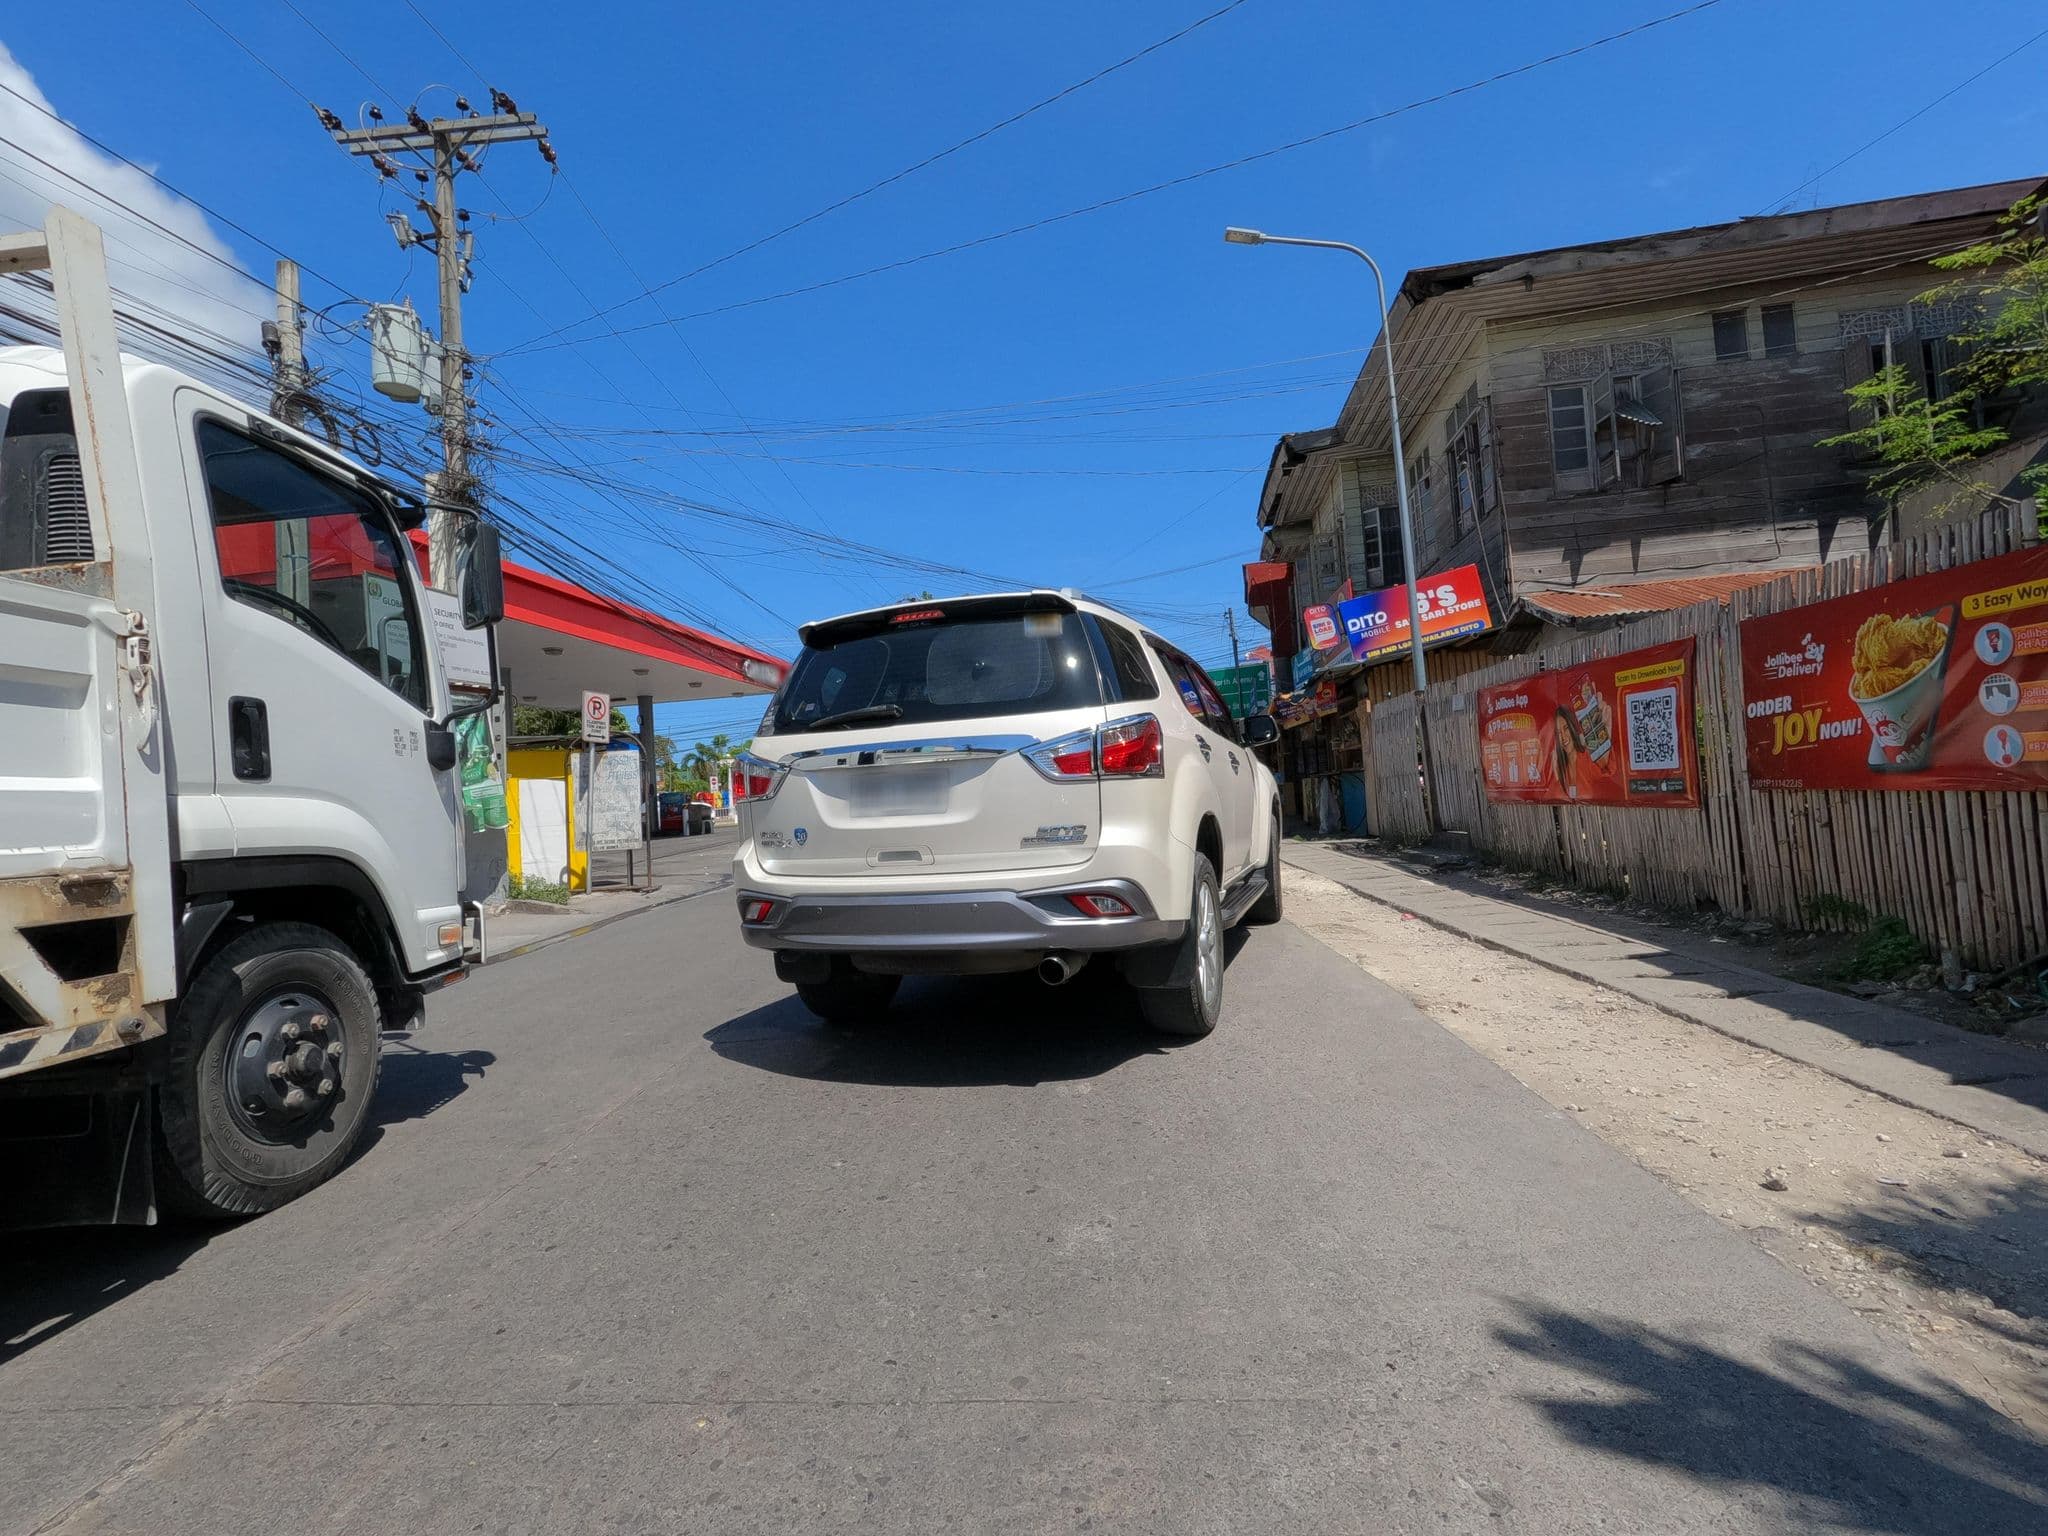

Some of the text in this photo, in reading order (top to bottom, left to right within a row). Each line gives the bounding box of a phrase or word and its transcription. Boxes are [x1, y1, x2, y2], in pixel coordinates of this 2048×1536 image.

[1972, 598, 1980, 610] 3
[1984, 592, 2013, 609] Easy
[1421, 609, 1445, 622] SARI
[1448, 598, 1482, 615] STORE
[1347, 611, 1388, 632] DITO
[1460, 623, 1480, 633] DITO
[1360, 625, 1391, 640] MOBILE
[2015, 628, 2048, 640] Jollibe
[1764, 652, 1803, 668] Jollibee
[1616, 673, 1630, 683] Scan
[1637, 667, 1666, 680] Download
[1777, 662, 1823, 679] Delivery
[2022, 686, 2048, 698] Jollib
[1747, 696, 1792, 718] ORDER
[1772, 709, 1823, 756] JOY
[1820, 717, 1863, 740] NOW!
